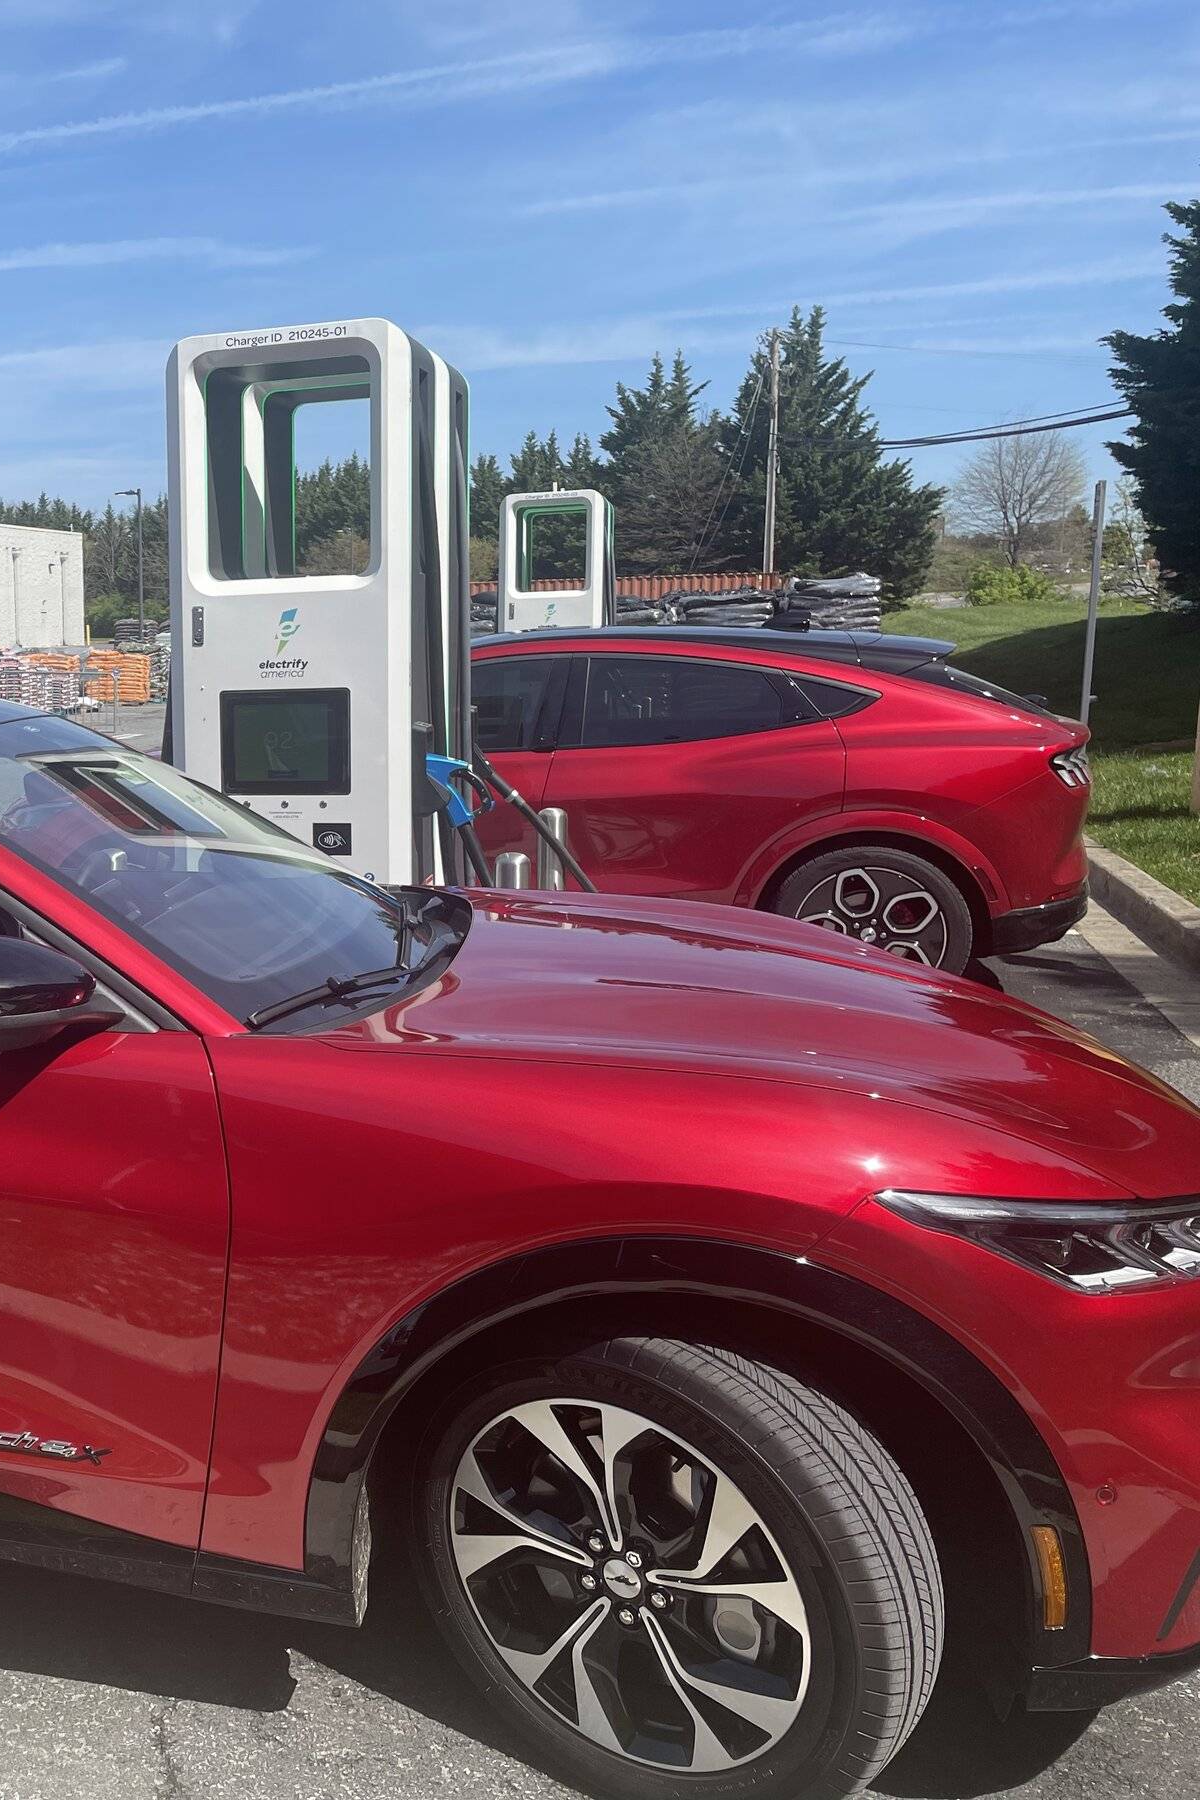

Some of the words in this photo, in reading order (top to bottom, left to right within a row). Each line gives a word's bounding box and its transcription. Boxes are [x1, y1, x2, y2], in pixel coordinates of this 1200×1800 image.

[225, 334, 269, 348] Charger
[271, 332, 283, 343] ID
[288, 326, 347, 341] 210245-01
[259, 658, 309, 671] electrify
[260, 669, 305, 679] america
